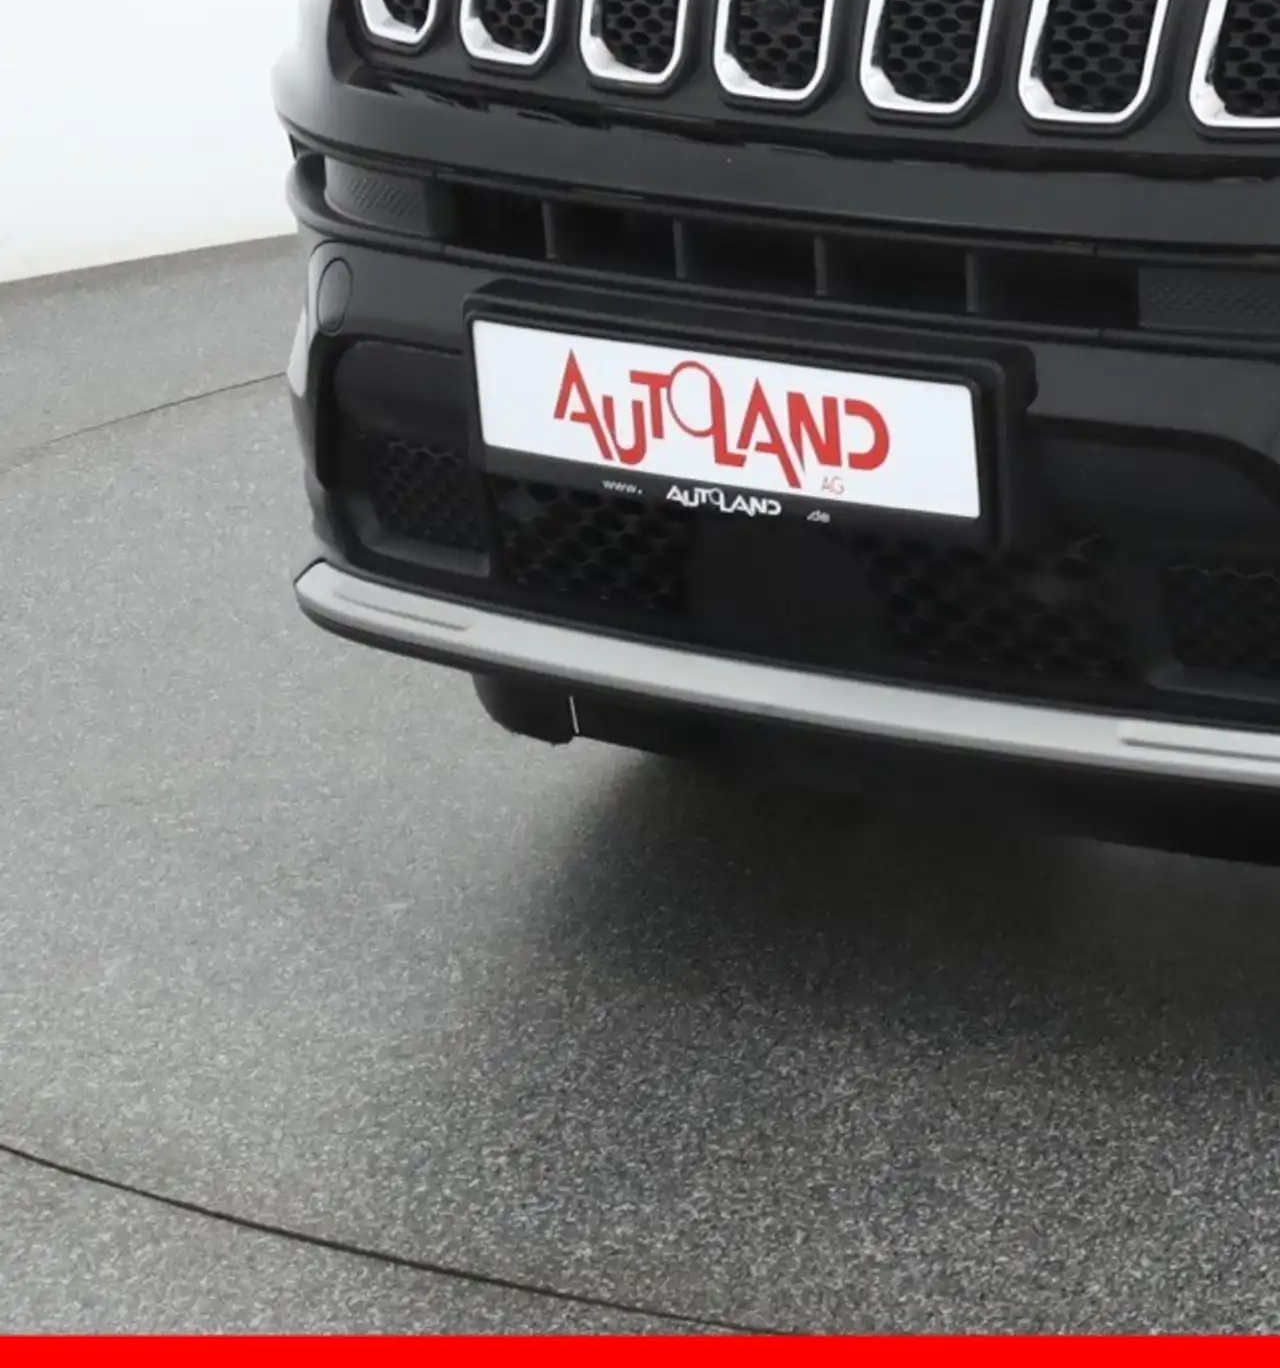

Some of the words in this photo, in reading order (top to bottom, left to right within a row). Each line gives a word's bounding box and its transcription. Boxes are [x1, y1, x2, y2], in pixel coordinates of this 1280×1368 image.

[553, 349, 890, 489] AUTOLAND
[666, 484, 782, 517] AUTOLAND
[820, 476, 845, 496] AG
